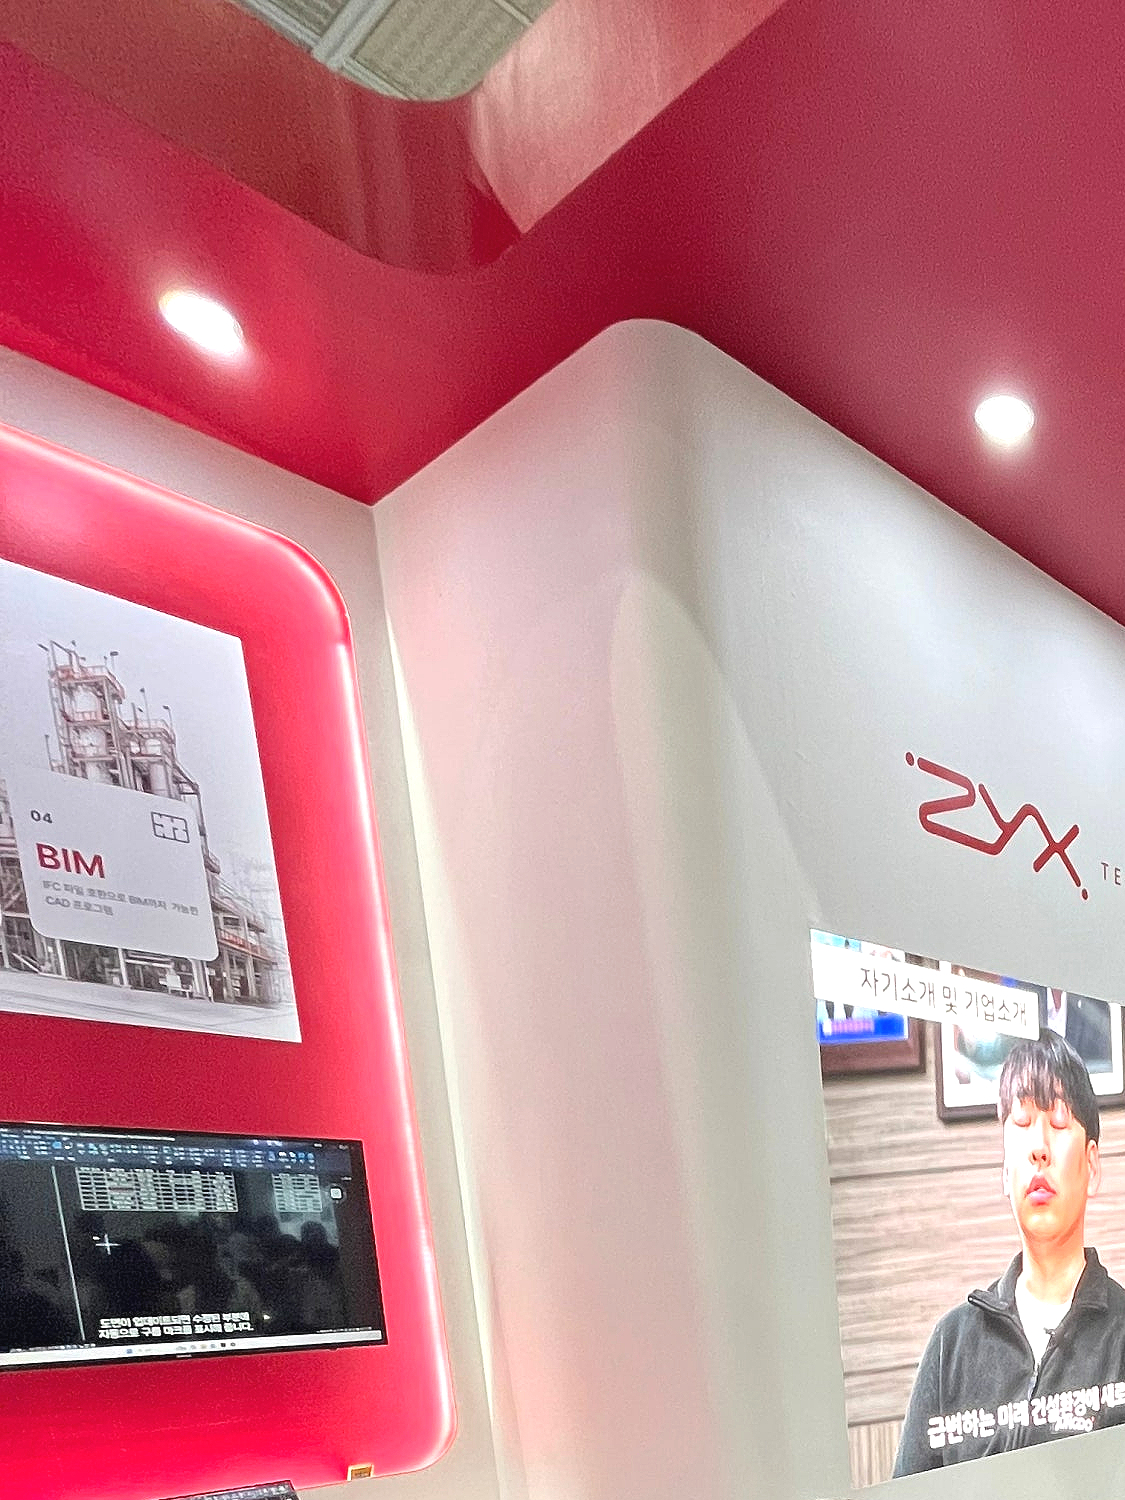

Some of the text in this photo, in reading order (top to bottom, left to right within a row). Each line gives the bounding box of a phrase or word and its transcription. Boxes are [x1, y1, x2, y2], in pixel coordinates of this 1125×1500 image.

[30, 809, 53, 824] 04
[36, 842, 106, 879] BIM
[45, 896, 71, 909] CAD
[860, 966, 1028, 1027] 자기소개 및 기업소개
[927, 1407, 997, 1449] 급변하는
[997, 1400, 1030, 1430] 미래
